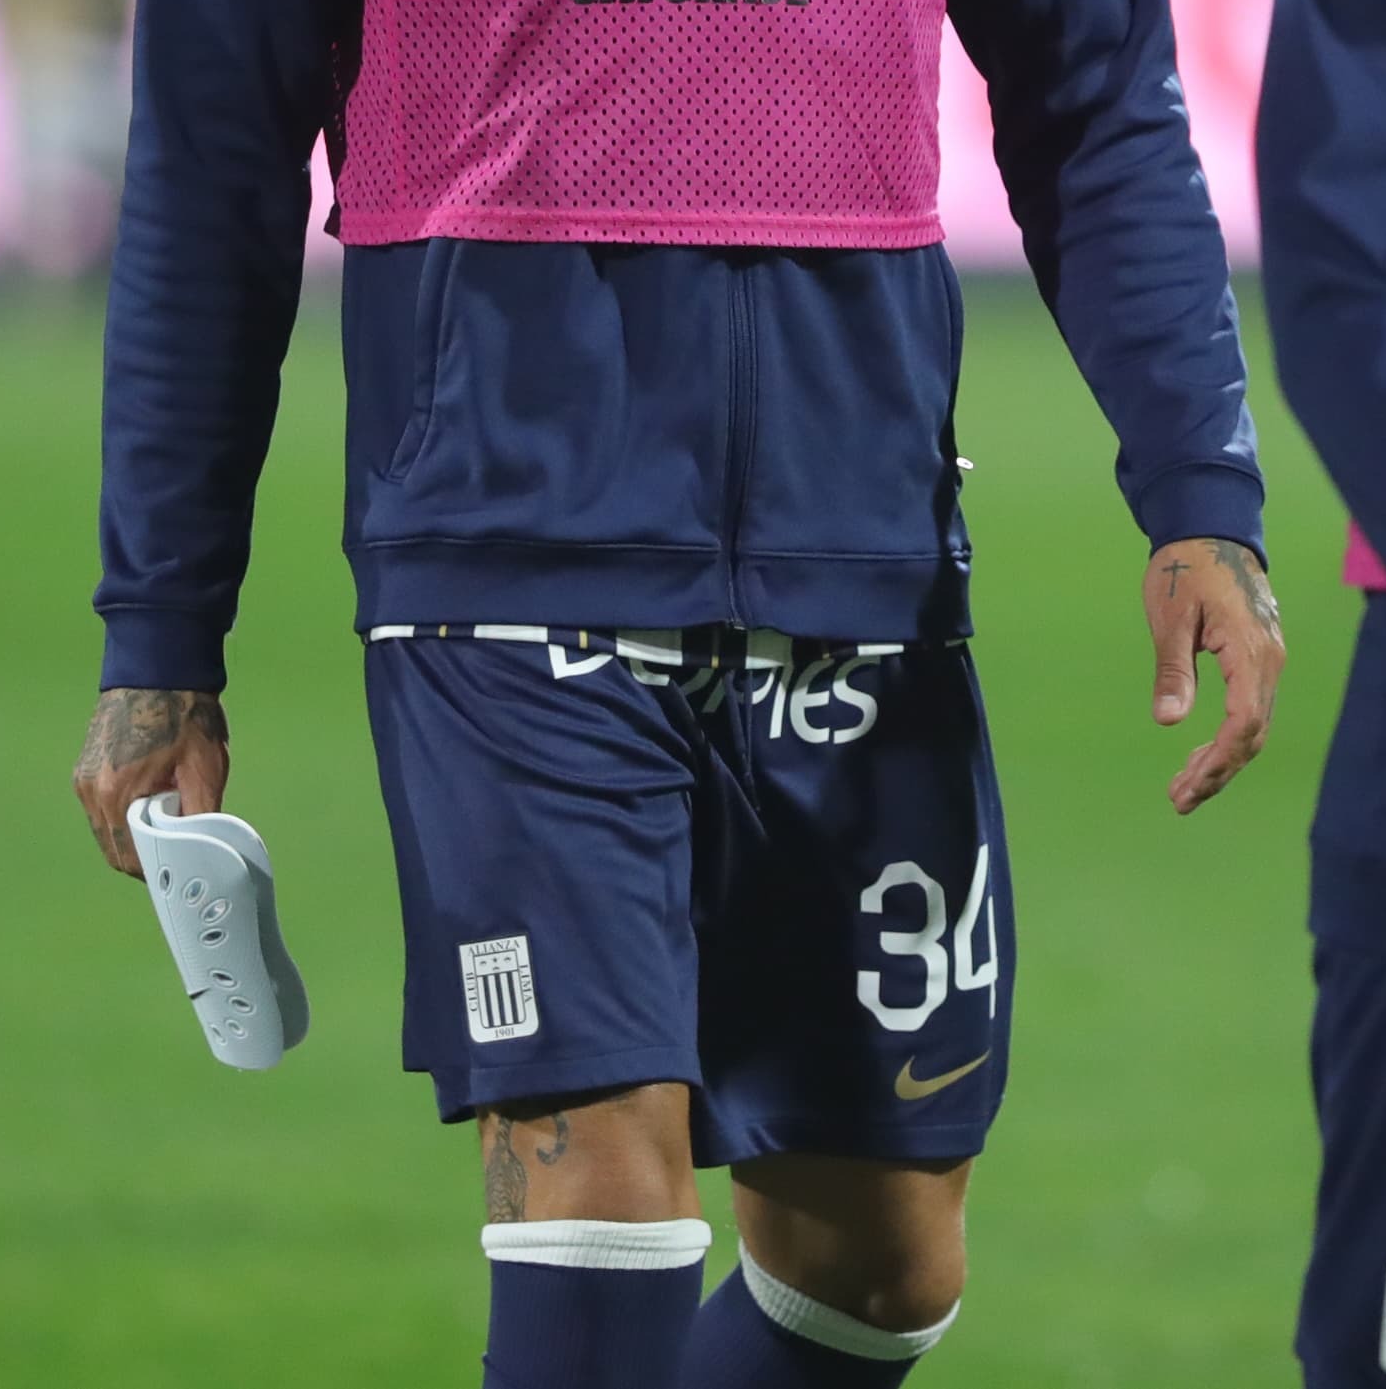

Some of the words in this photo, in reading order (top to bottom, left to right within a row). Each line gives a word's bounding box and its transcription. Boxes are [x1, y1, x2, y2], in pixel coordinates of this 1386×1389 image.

[468, 939, 521, 956] ALIANZA
[856, 843, 999, 1032] 34
[465, 972, 479, 1012] CLUB
[519, 964, 533, 1003] LIMA
[494, 1027, 516, 1039] 1901
